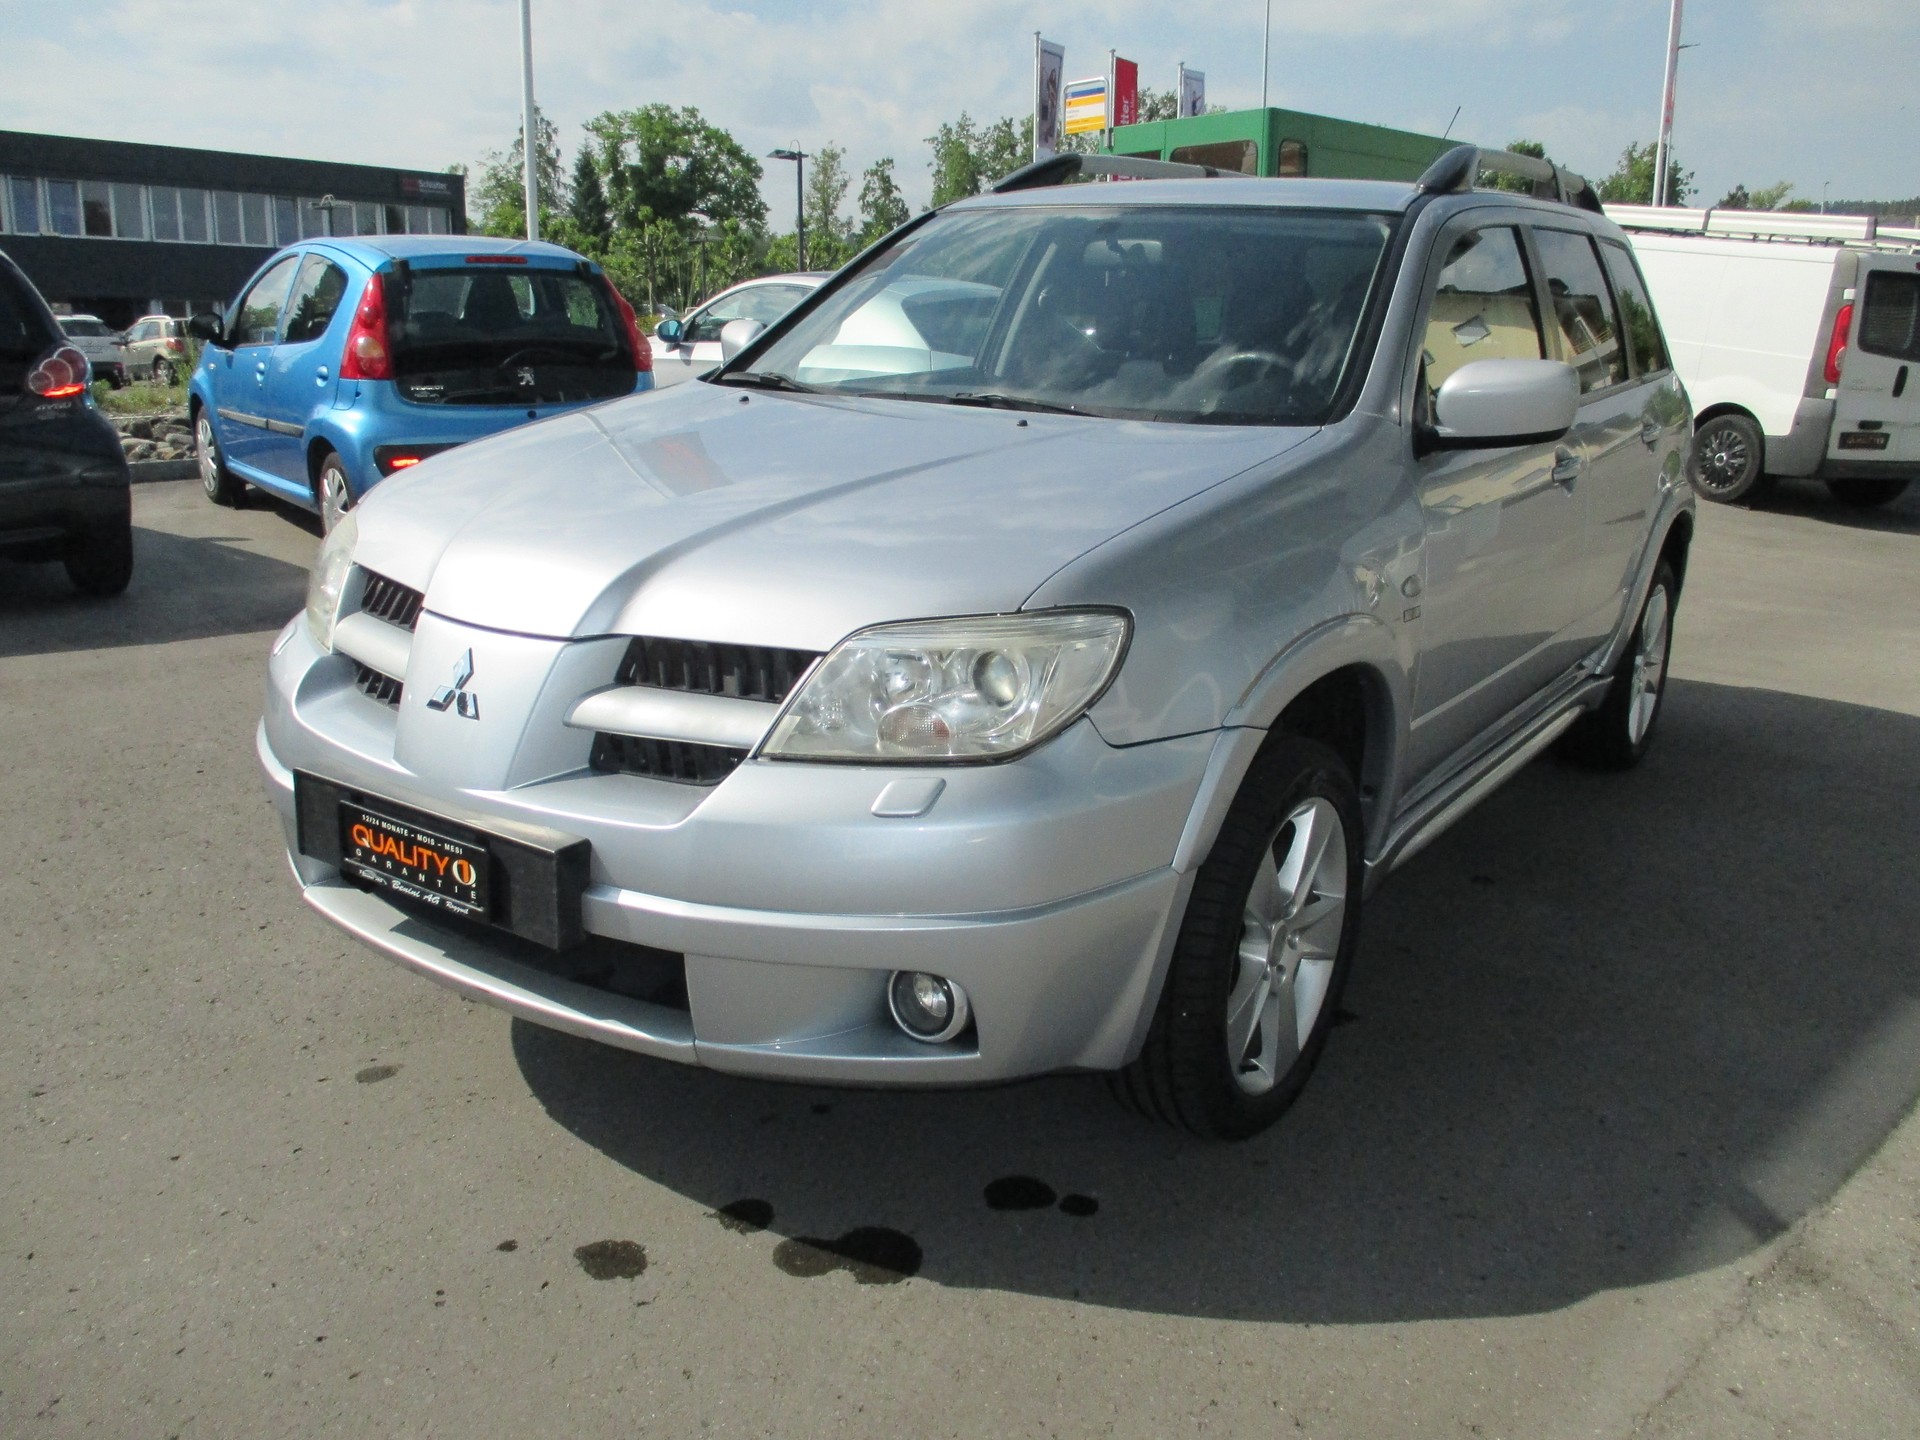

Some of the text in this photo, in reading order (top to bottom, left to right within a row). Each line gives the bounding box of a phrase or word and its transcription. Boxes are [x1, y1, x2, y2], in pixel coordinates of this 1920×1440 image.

[352, 824, 450, 876] QUALITY
[381, 821, 409, 837] MONATE
[416, 833, 435, 846] MOIS
[444, 843, 463, 855] MESI
[422, 893, 441, 905] AG
